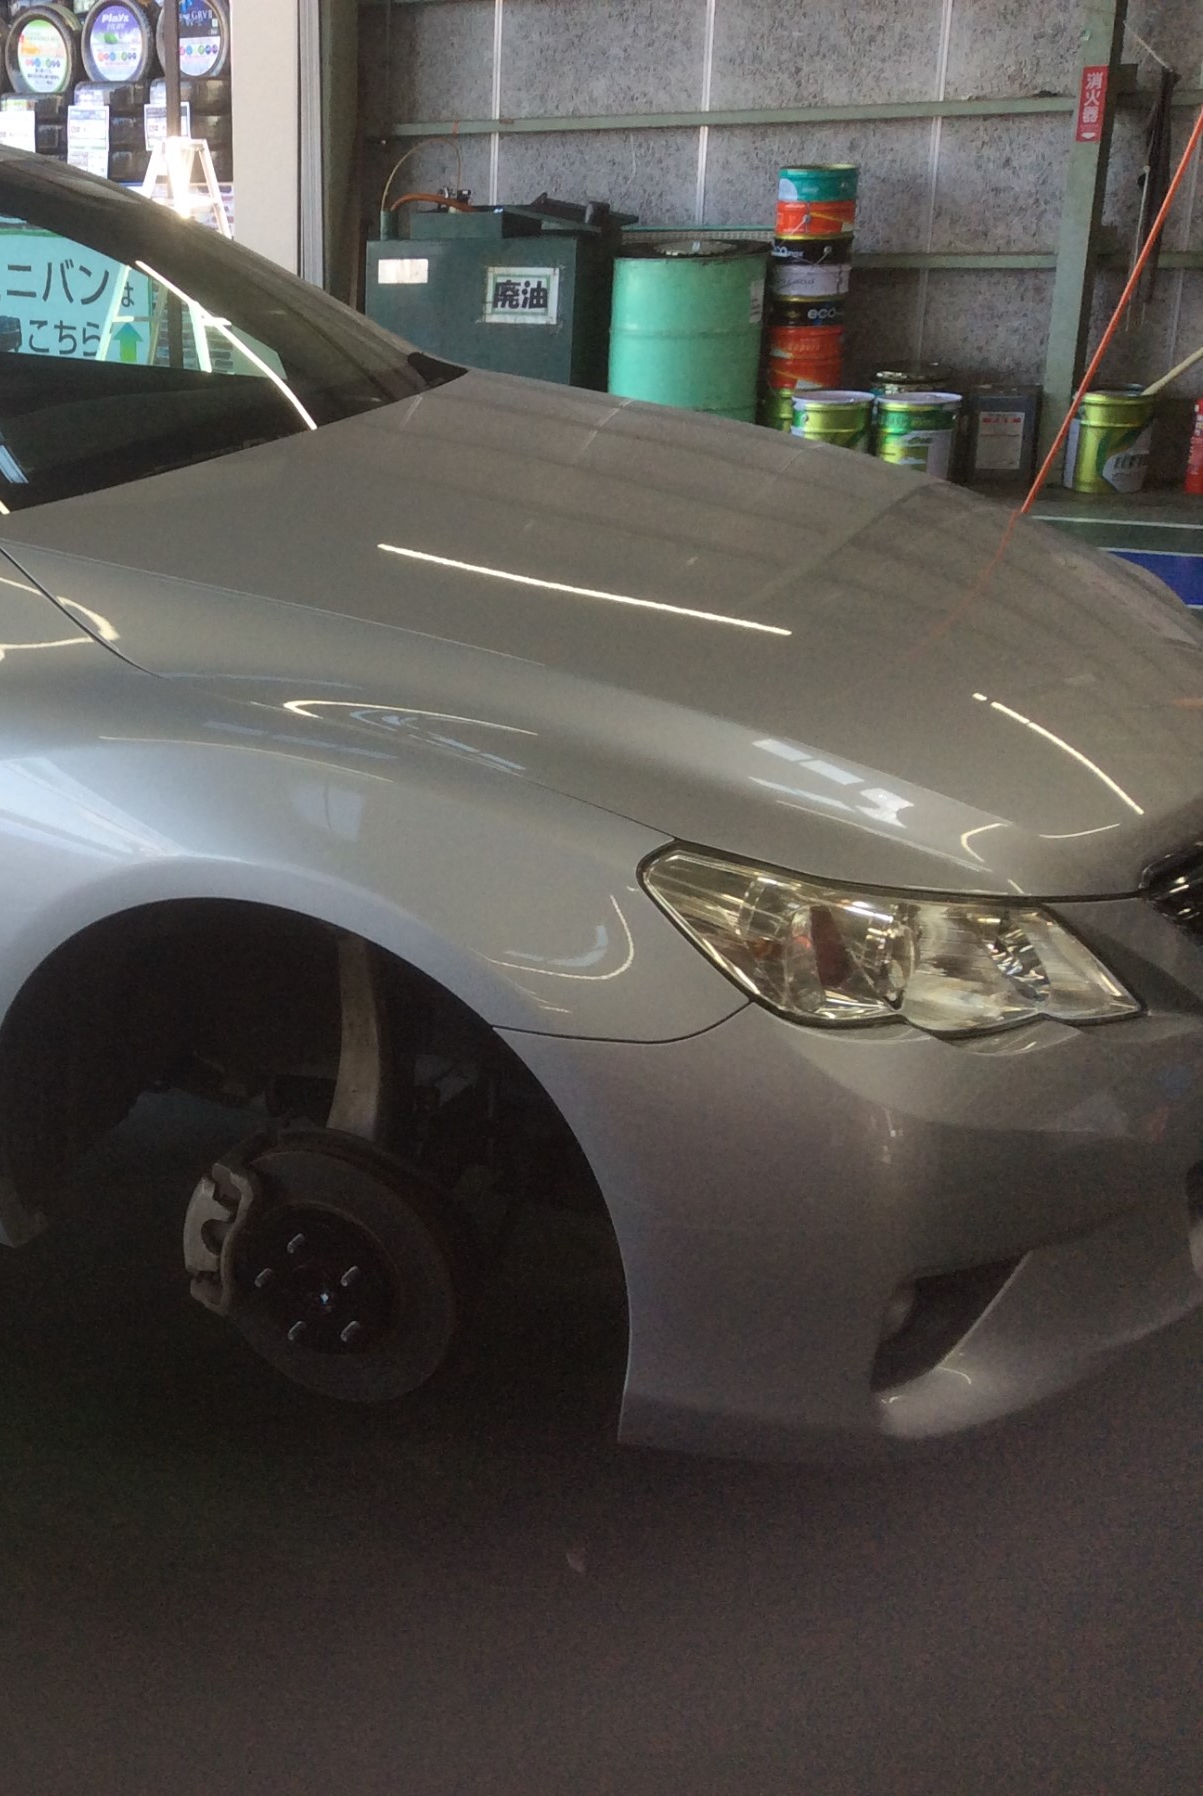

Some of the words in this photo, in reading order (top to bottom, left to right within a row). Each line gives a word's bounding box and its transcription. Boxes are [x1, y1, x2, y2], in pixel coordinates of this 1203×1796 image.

[1084, 72, 1104, 123] 消火器
[493, 280, 549, 309] 廃油
[29, 320, 101, 357] こちら
